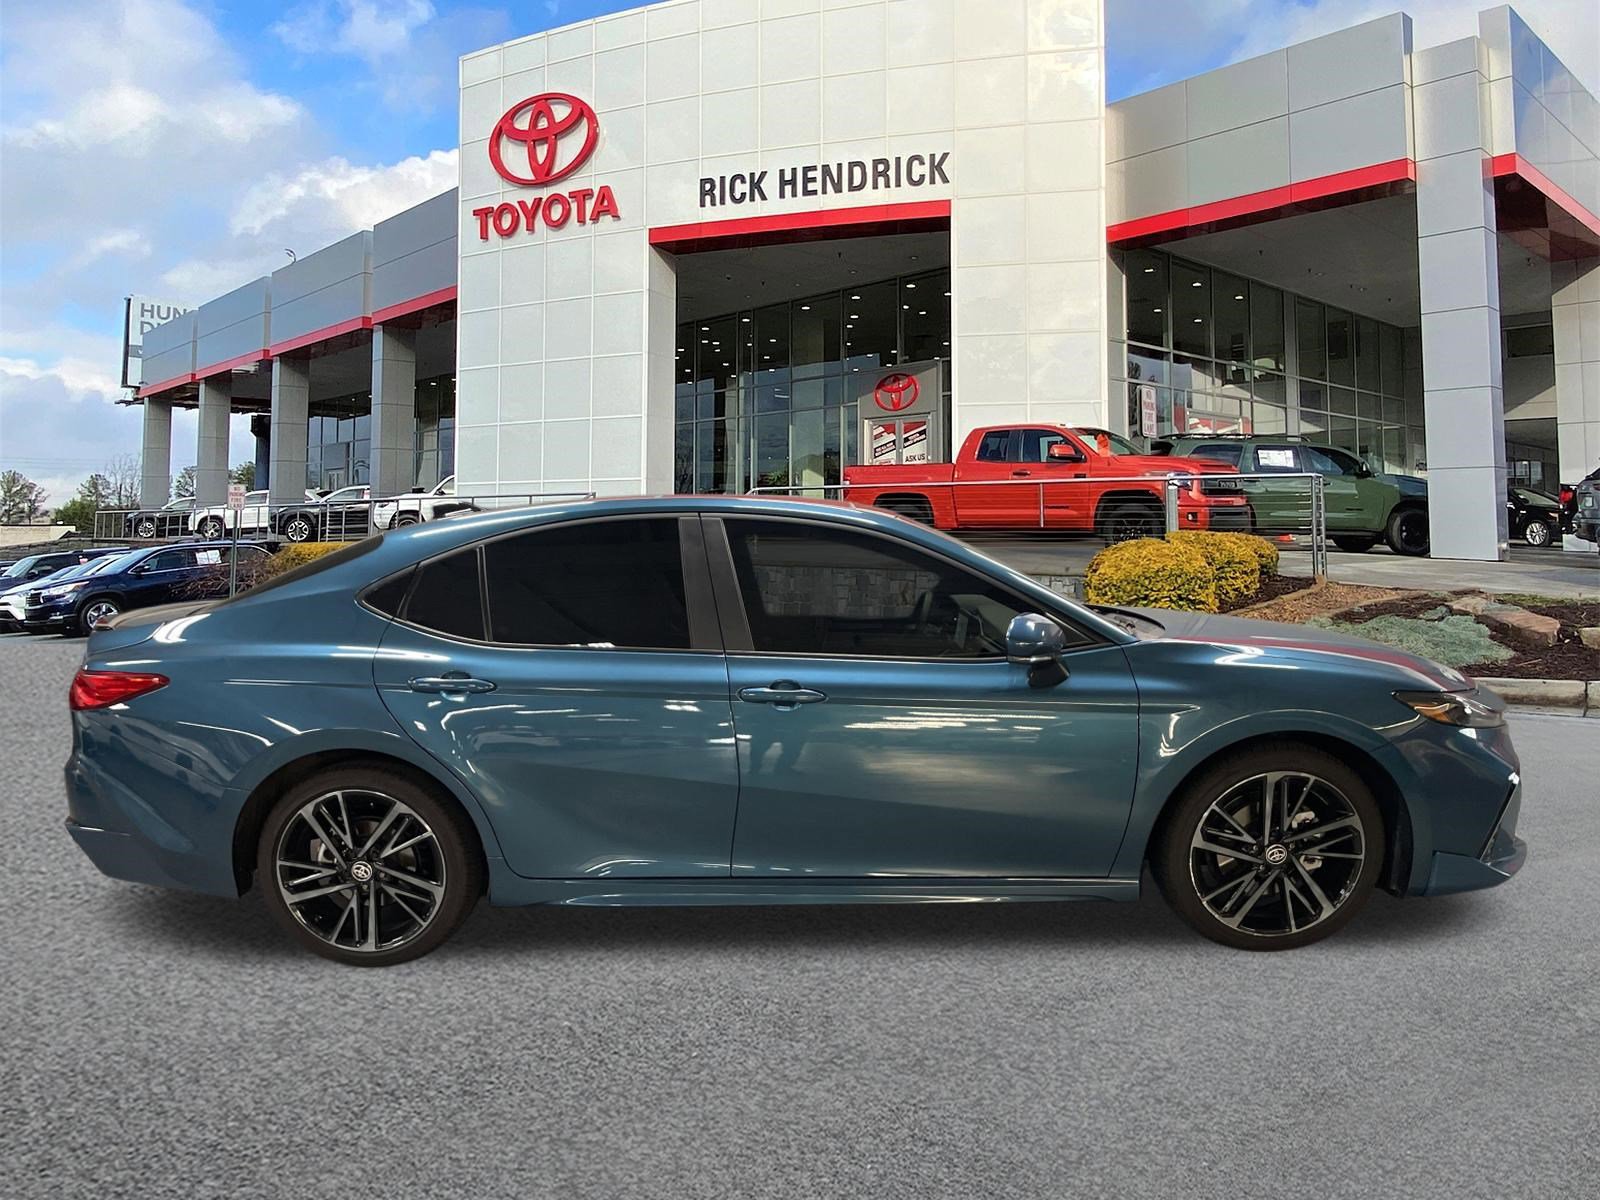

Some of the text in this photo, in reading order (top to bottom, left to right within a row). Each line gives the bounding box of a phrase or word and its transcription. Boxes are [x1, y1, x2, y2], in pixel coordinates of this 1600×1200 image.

[699, 152, 951, 208] RICK HENDRICK
[472, 185, 621, 241] TOYOTA
[905, 455, 917, 463] ASK
[917, 453, 926, 461] US
